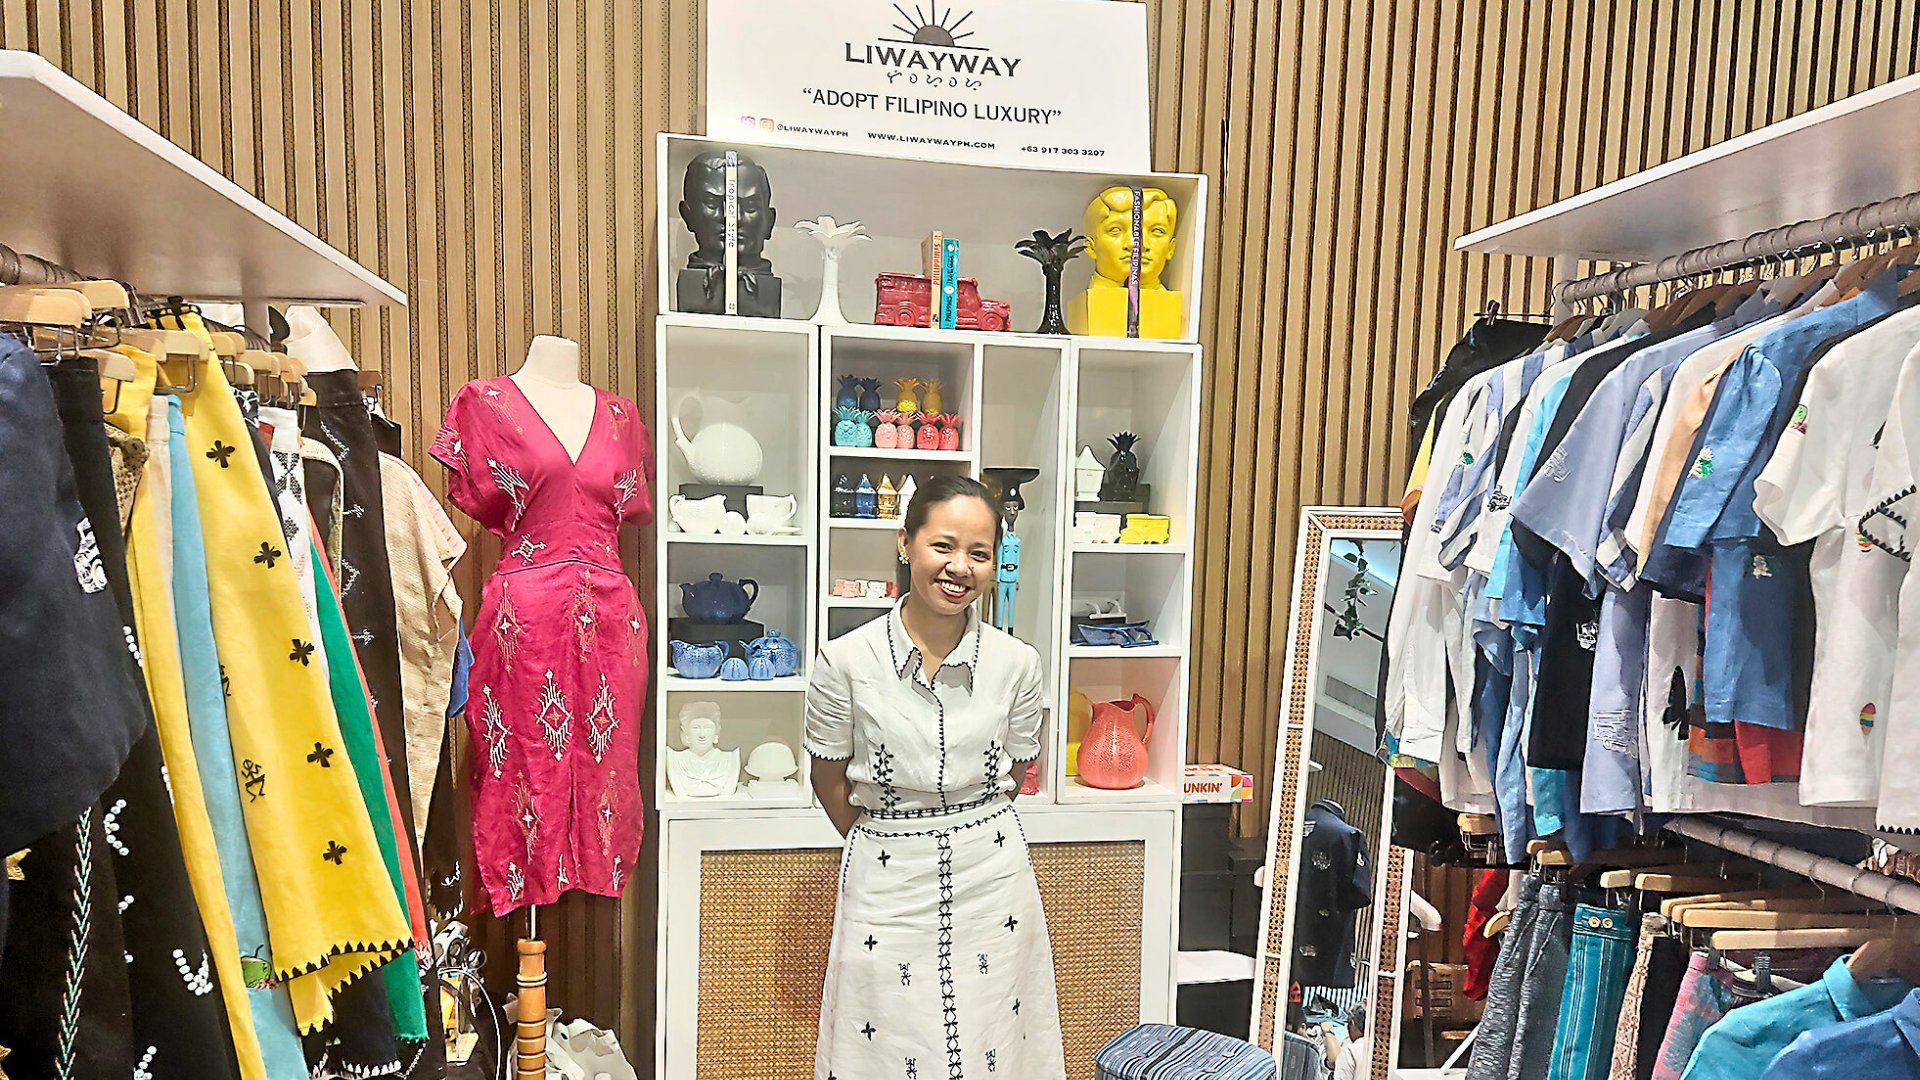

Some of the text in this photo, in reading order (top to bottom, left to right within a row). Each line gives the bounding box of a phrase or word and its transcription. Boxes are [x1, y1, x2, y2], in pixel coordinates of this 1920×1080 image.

[845, 42, 1021, 77] LIWAYWAY
[802, 87, 1062, 125] “ADOPT FILIPINO LUXURY”
[777, 123, 849, 137] @LIWAYWAYPH
[867, 132, 995, 149] WWW.LIWAYWAYPH.COM
[1021, 145, 1038, 153] +63
[1081, 149, 1105, 157] 3207
[727, 180, 736, 248] Tropical Style
[1131, 247, 1139, 285] FILIPINAS
[1184, 782, 1223, 793] UNKIN'
